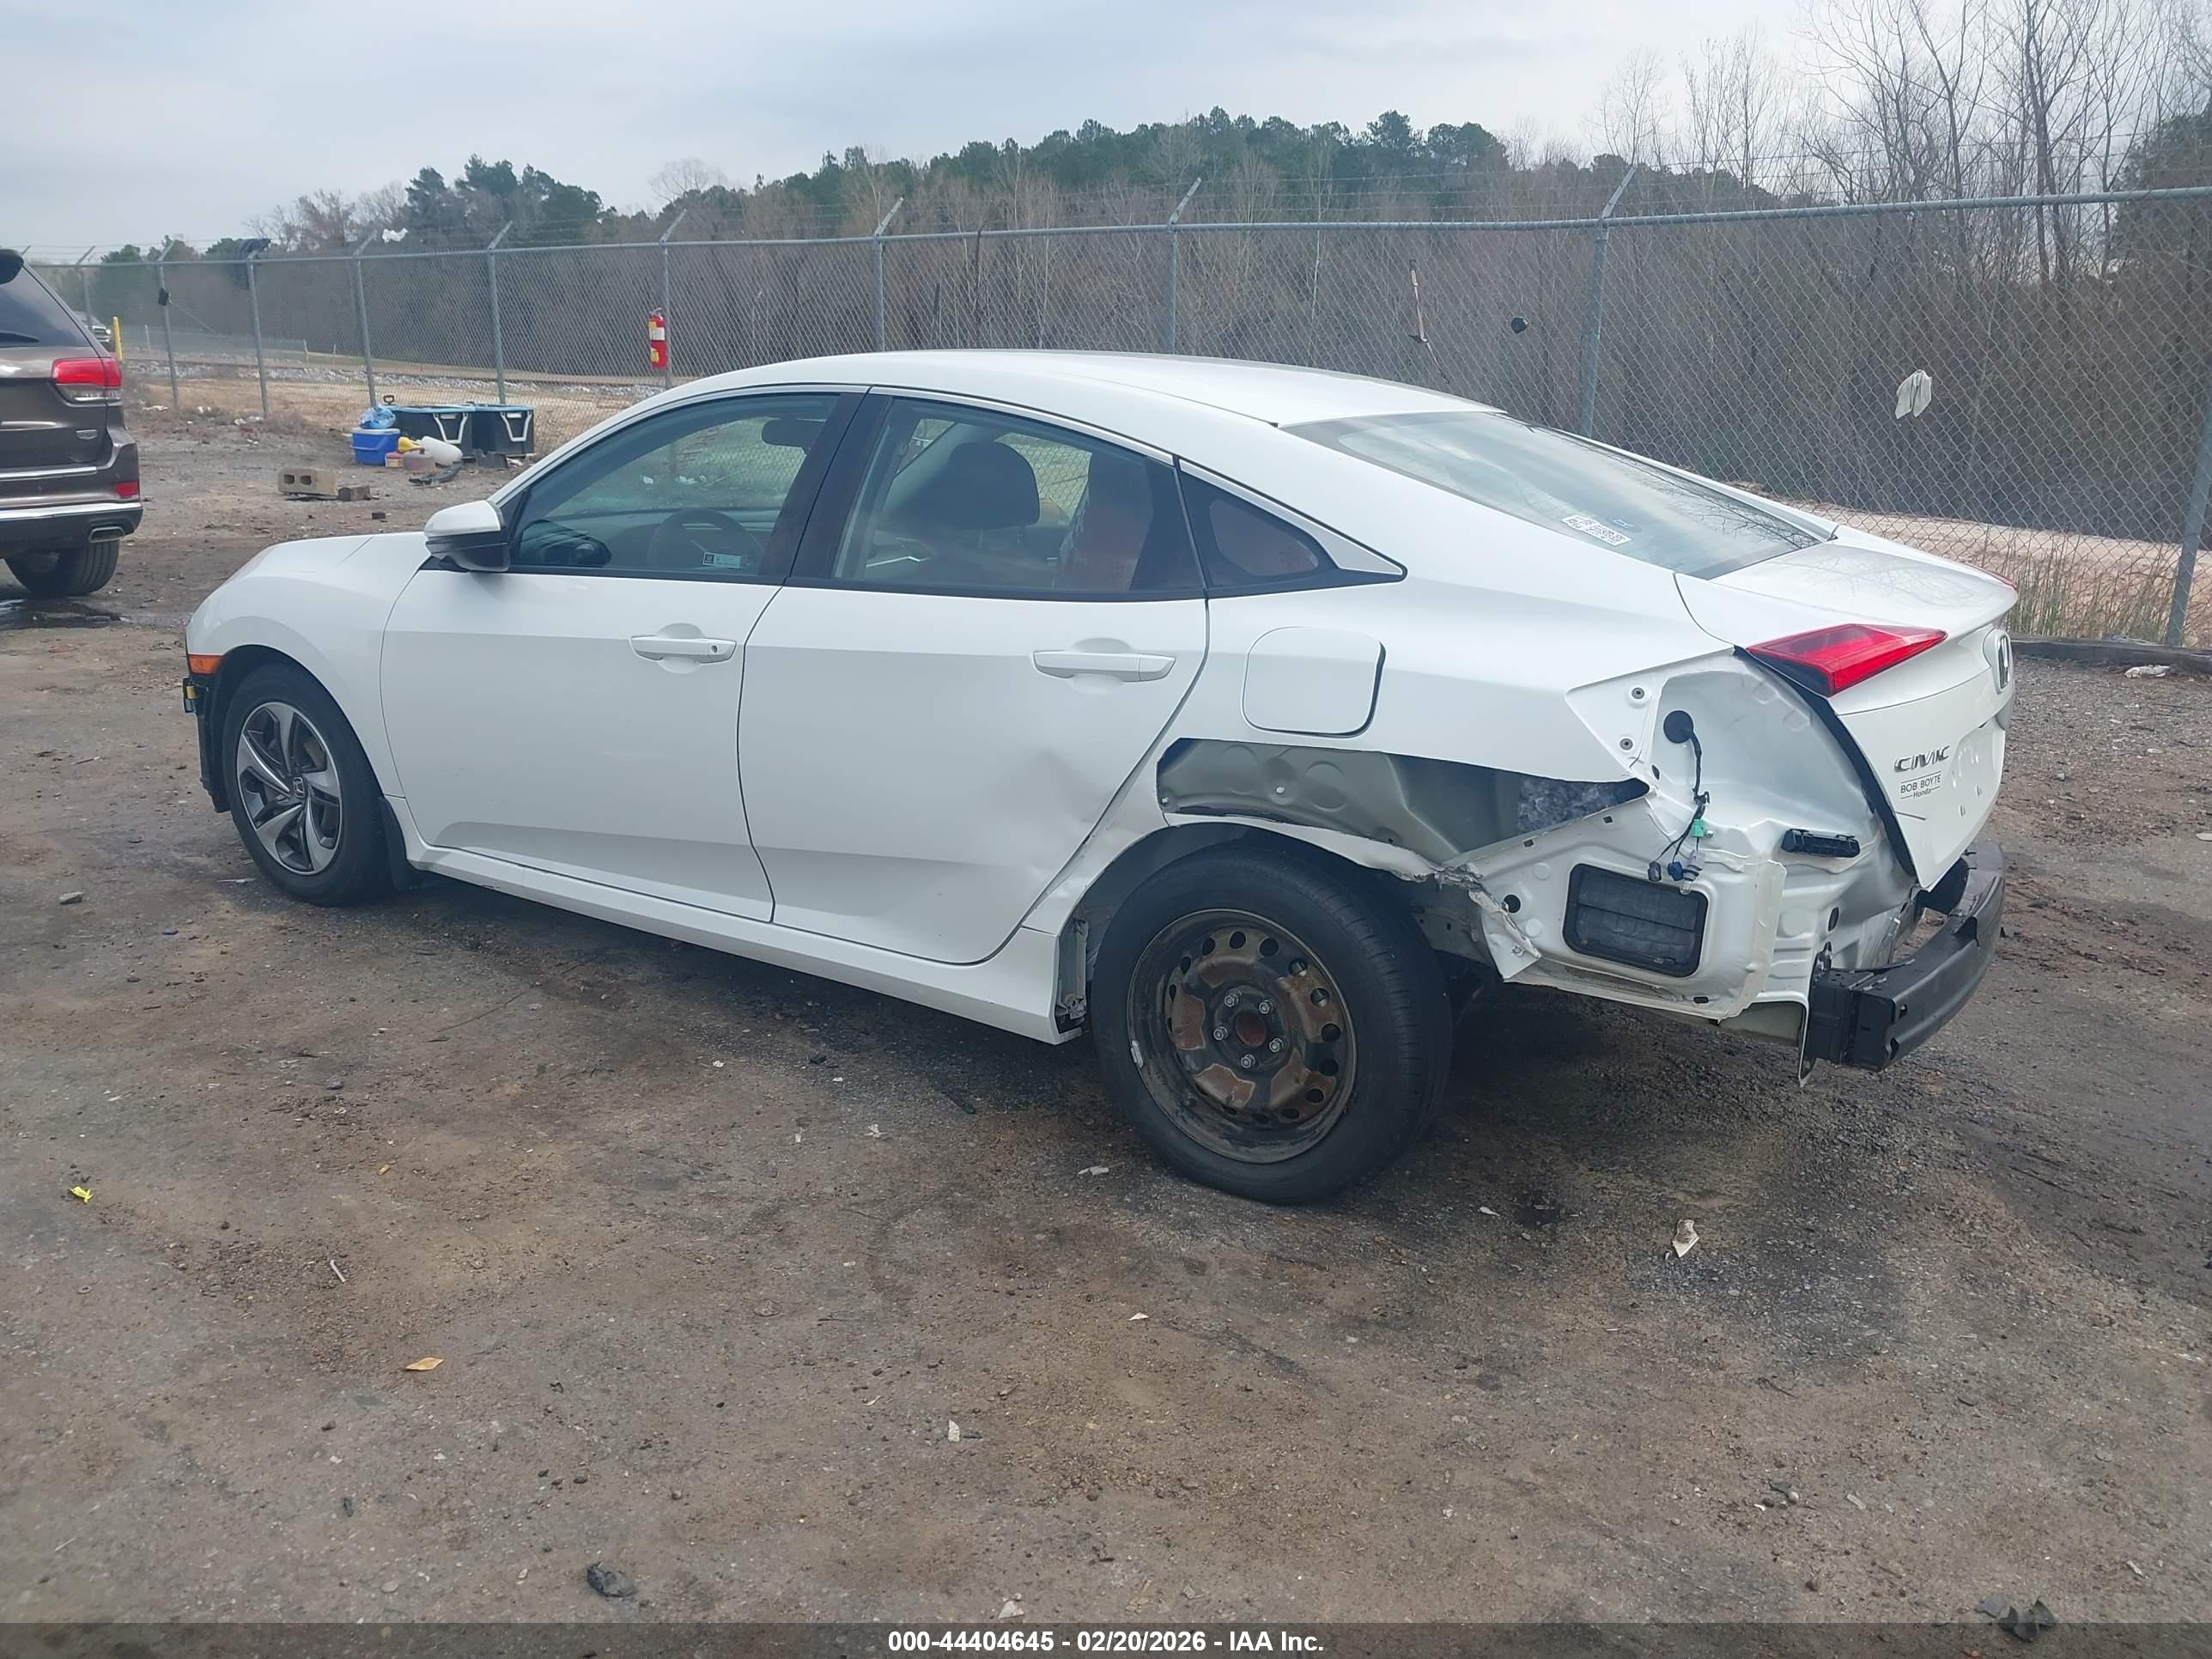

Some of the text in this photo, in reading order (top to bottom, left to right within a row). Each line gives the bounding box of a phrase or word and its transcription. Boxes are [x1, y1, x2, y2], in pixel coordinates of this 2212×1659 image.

[1893, 745, 1950, 773] CIVIC
[1900, 774, 1942, 793] BOB BOYTE
[1913, 787, 1931, 799] Honda
